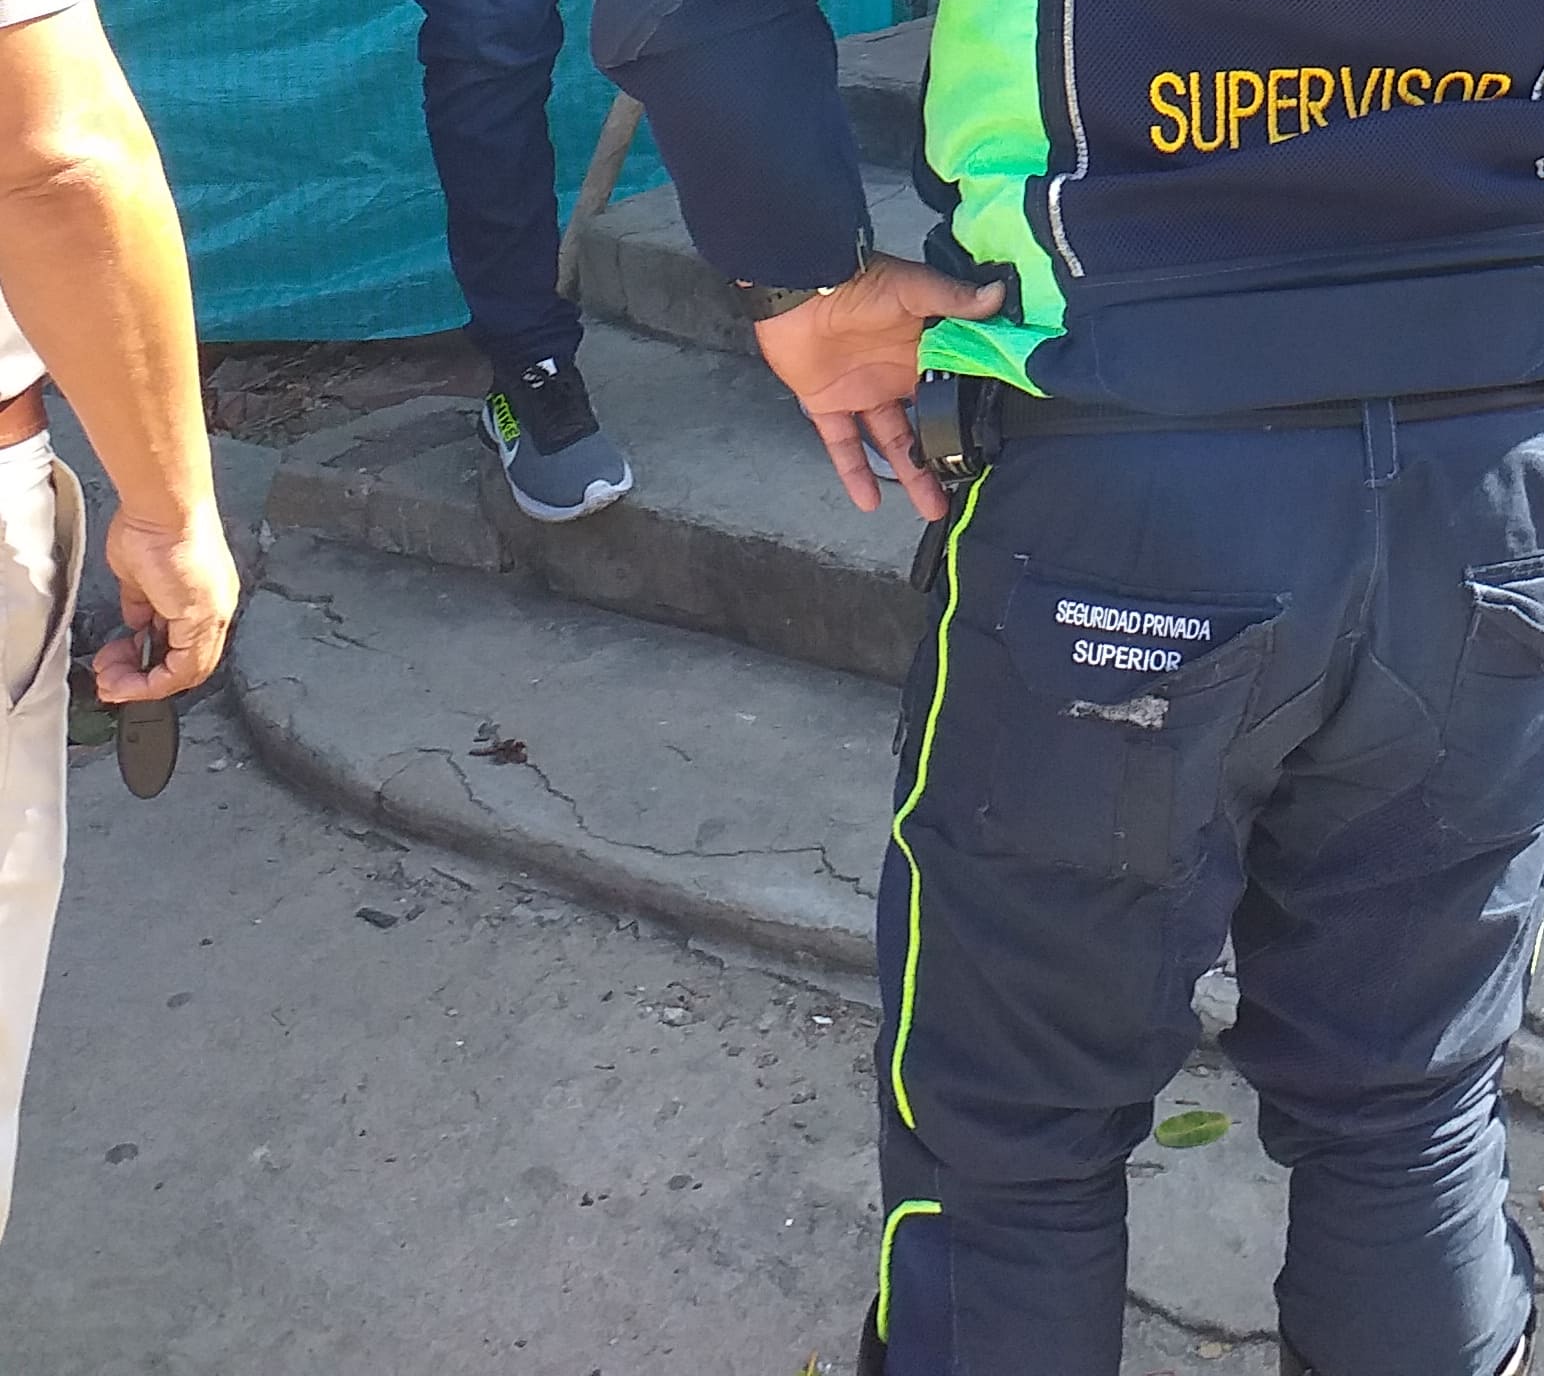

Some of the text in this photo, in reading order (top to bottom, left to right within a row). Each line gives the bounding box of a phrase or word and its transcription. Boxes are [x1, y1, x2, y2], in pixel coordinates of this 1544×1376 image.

[1055, 599, 1212, 641] SEGURIDAD PRIVADA
[1072, 640, 1182, 673] SUPERIOR
